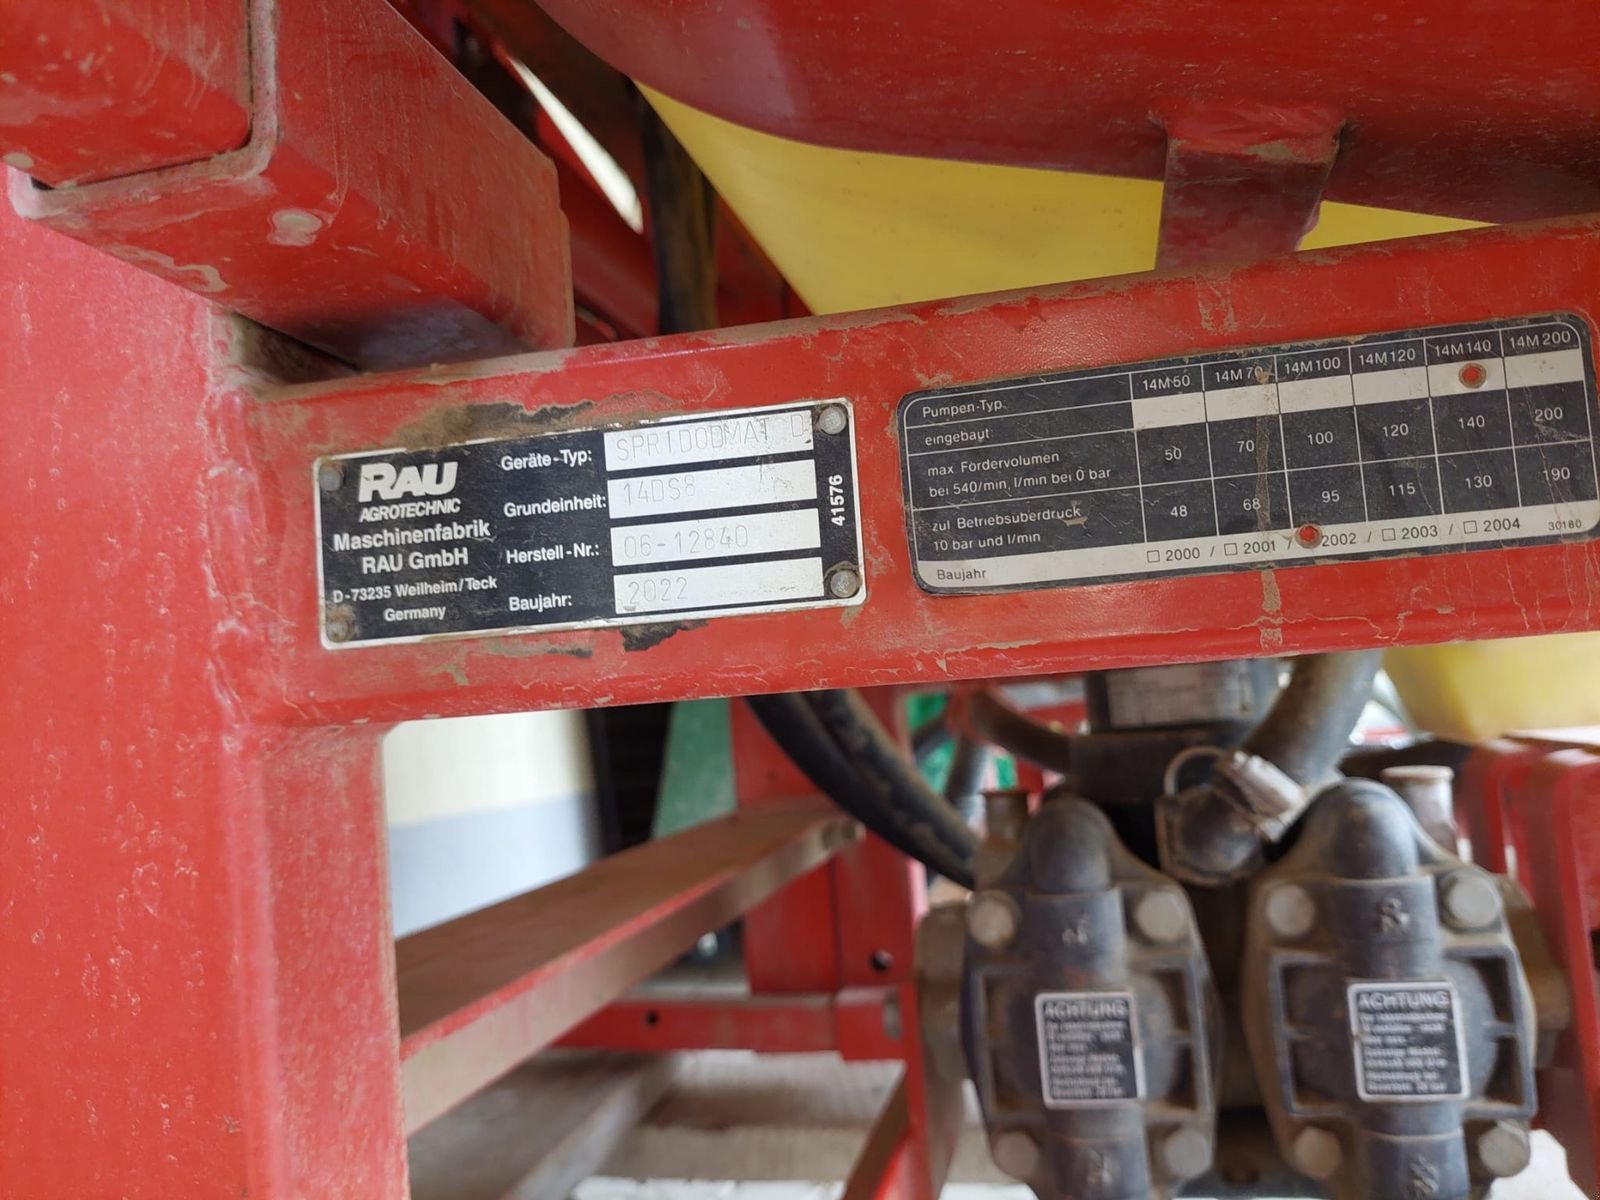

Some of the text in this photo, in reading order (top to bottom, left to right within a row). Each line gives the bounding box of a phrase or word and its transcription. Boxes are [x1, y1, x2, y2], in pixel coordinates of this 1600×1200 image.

[1459, 415, 1485, 429] 140
[1534, 407, 1562, 422] 200
[1307, 431, 1334, 445] 100
[1383, 424, 1409, 438] 120
[1164, 447, 1182, 461] 50
[1237, 439, 1254, 453] 70
[1089, 468, 1111, 479] bar
[1465, 474, 1492, 489] 130
[1543, 466, 1570, 482] 190
[358, 462, 457, 502] RAU
[624, 476, 696, 504] 14DS8
[1389, 481, 1416, 497] 115
[829, 474, 846, 527] 41576
[1243, 497, 1261, 511] 68
[1321, 490, 1340, 504] 95
[359, 498, 461, 522] AGROTECHNIC
[504, 494, 606, 517] Grundeinheit:
[1170, 505, 1188, 518] 48
[334, 520, 491, 551] Maschinenfabrik
[624, 525, 749, 559] 06-12840
[933, 540, 948, 551] 10
[952, 539, 974, 550] bar
[978, 536, 1003, 547] und
[1165, 547, 1200, 562] 2000
[1243, 540, 1276, 554] 2001
[1321, 533, 1357, 546] 2002
[1401, 525, 1438, 540] 2003
[1483, 518, 1520, 533] 2004
[1548, 519, 1582, 531] 30180
[363, 548, 469, 574] RAU GmbH
[937, 569, 987, 581] Baujahr
[628, 577, 689, 605] 2022
[509, 593, 572, 612] Baujahr:
[384, 606, 446, 622] Germany
